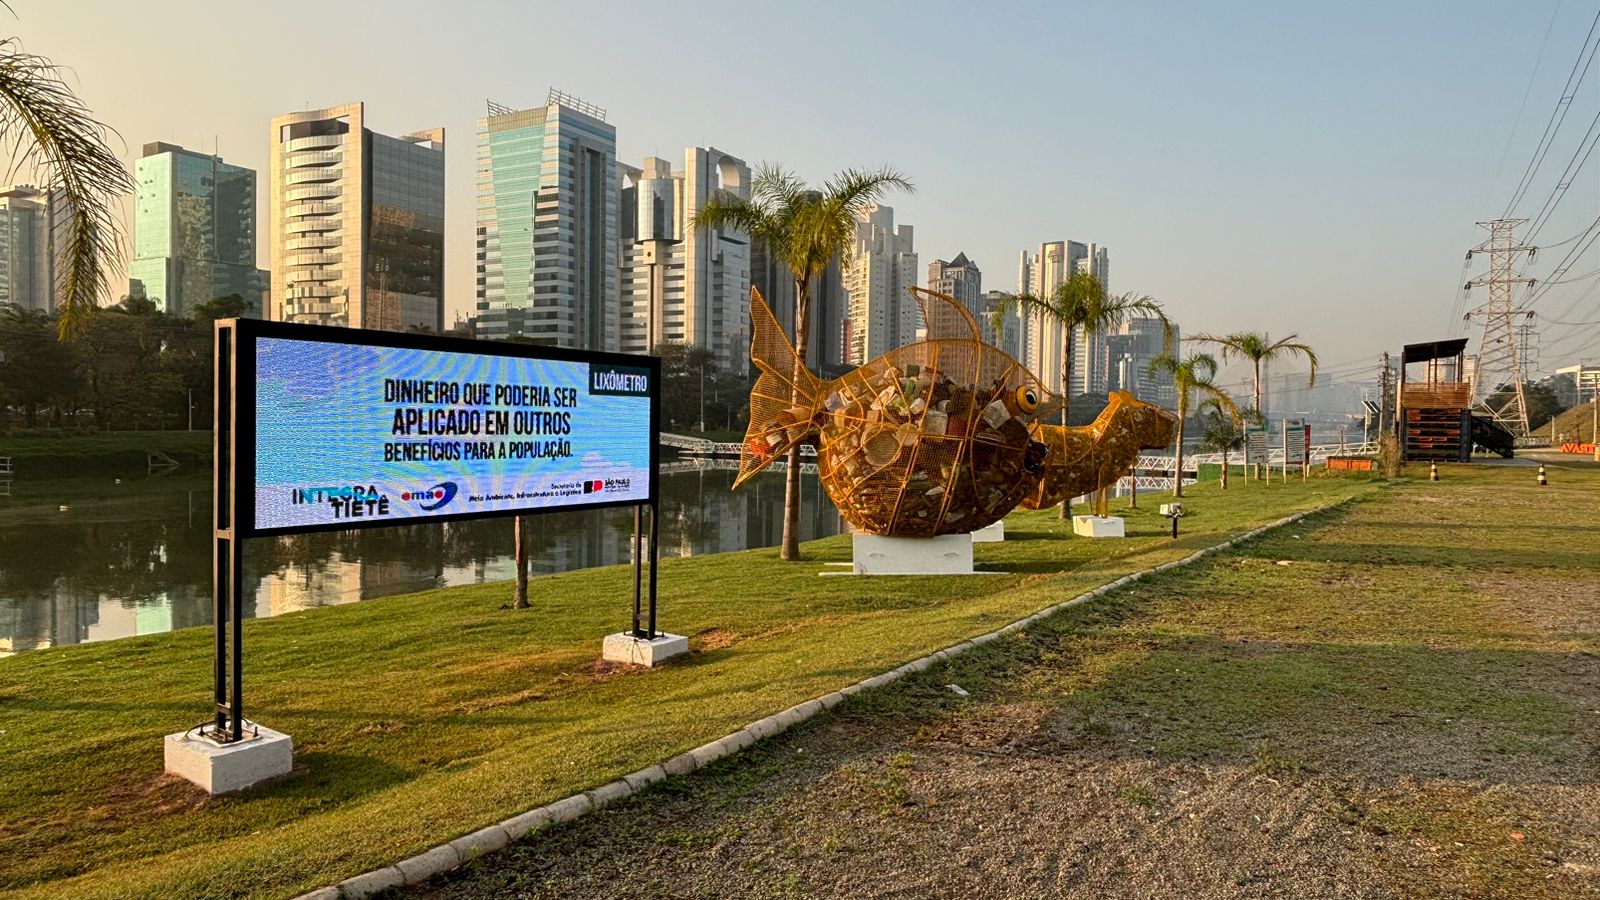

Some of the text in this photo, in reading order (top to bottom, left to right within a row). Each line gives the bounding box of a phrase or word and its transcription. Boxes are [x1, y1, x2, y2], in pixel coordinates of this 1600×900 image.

[384, 378, 577, 408] DINHEIRO QUE PODERIA SER
[594, 370, 647, 392] LIXÔMETRO
[392, 408, 571, 435] APLICADO EM OUTROS
[384, 437, 573, 462] BENEFÍCIOS PARA A POPULAÇÃO.
[331, 494, 389, 518] TIETÊ
